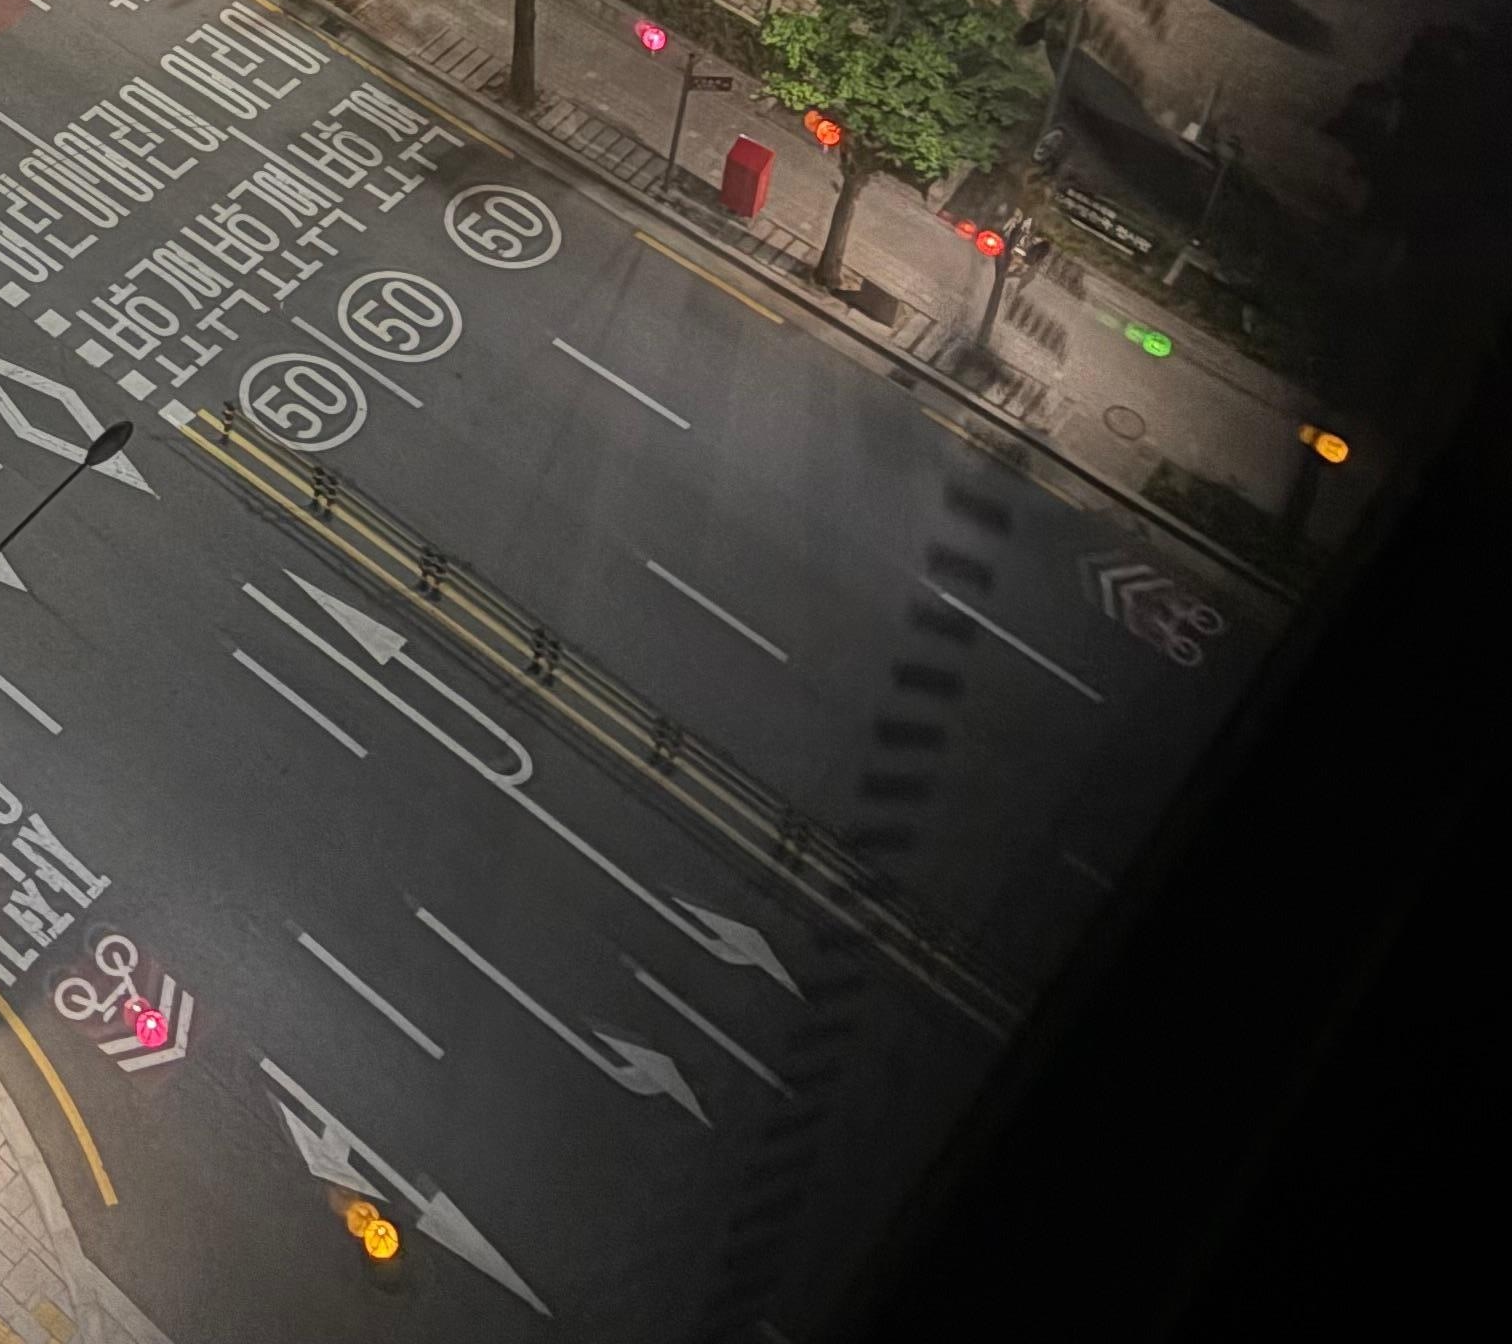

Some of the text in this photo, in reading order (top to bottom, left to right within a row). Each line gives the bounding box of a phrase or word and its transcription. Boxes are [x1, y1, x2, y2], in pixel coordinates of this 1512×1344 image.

[53, 76, 229, 202] 어린이
[159, 0, 332, 120] 어린이
[75, 81, 466, 389] 보호구역 보호구역 보호구역
[248, 195, 546, 441] 50 50 50
